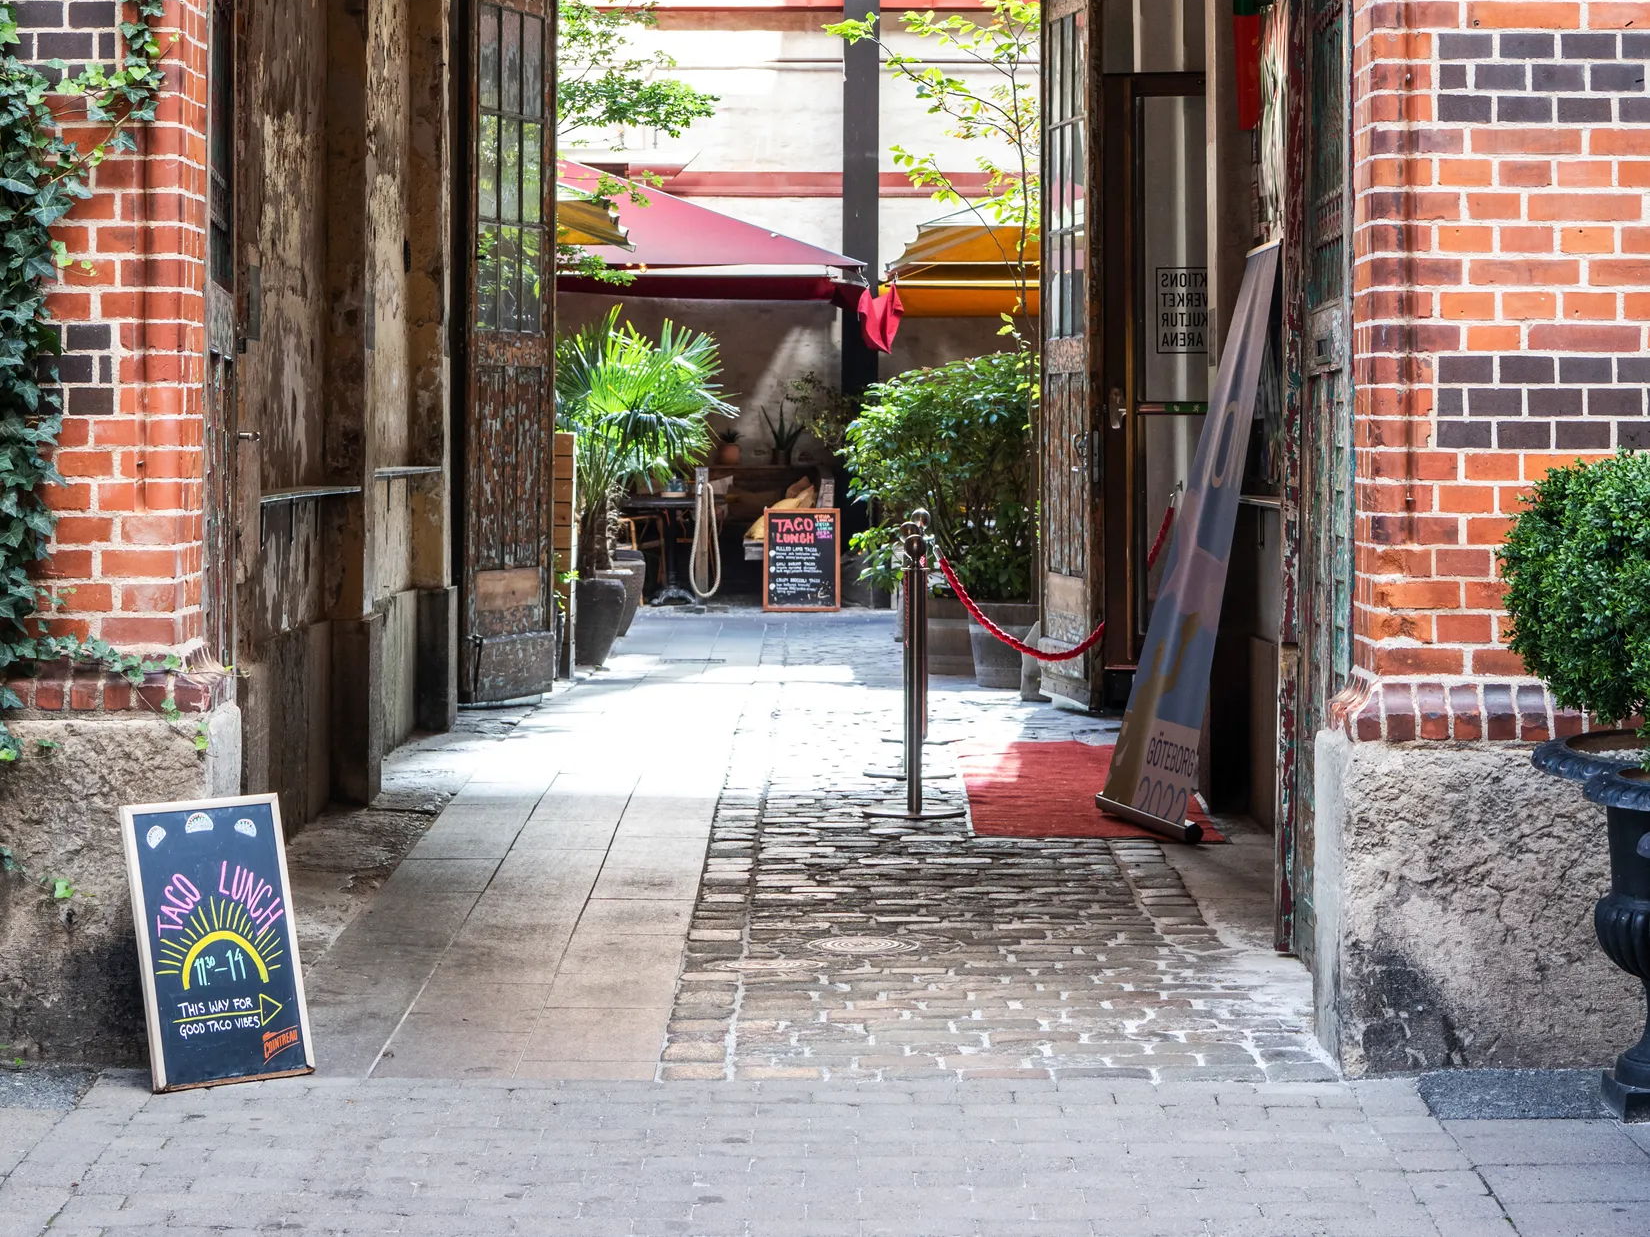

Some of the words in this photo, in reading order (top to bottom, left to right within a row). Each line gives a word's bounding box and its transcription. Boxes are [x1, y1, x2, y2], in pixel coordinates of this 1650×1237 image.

[771, 517, 814, 533] TACO
[776, 533, 815, 544] LUNCH
[1145, 731, 1196, 778] GÖTEBORG
[156, 873, 201, 937] TACO
[219, 860, 284, 937] LUNCH
[177, 1002, 205, 1018] THIS
[208, 999, 230, 1013] WAY
[232, 997, 254, 1010] FOR
[179, 1023, 206, 1039] GOOD
[207, 1020, 232, 1033] TACO
[234, 1016, 261, 1029] VIBES
[263, 1029, 299, 1059] COINTREAU
